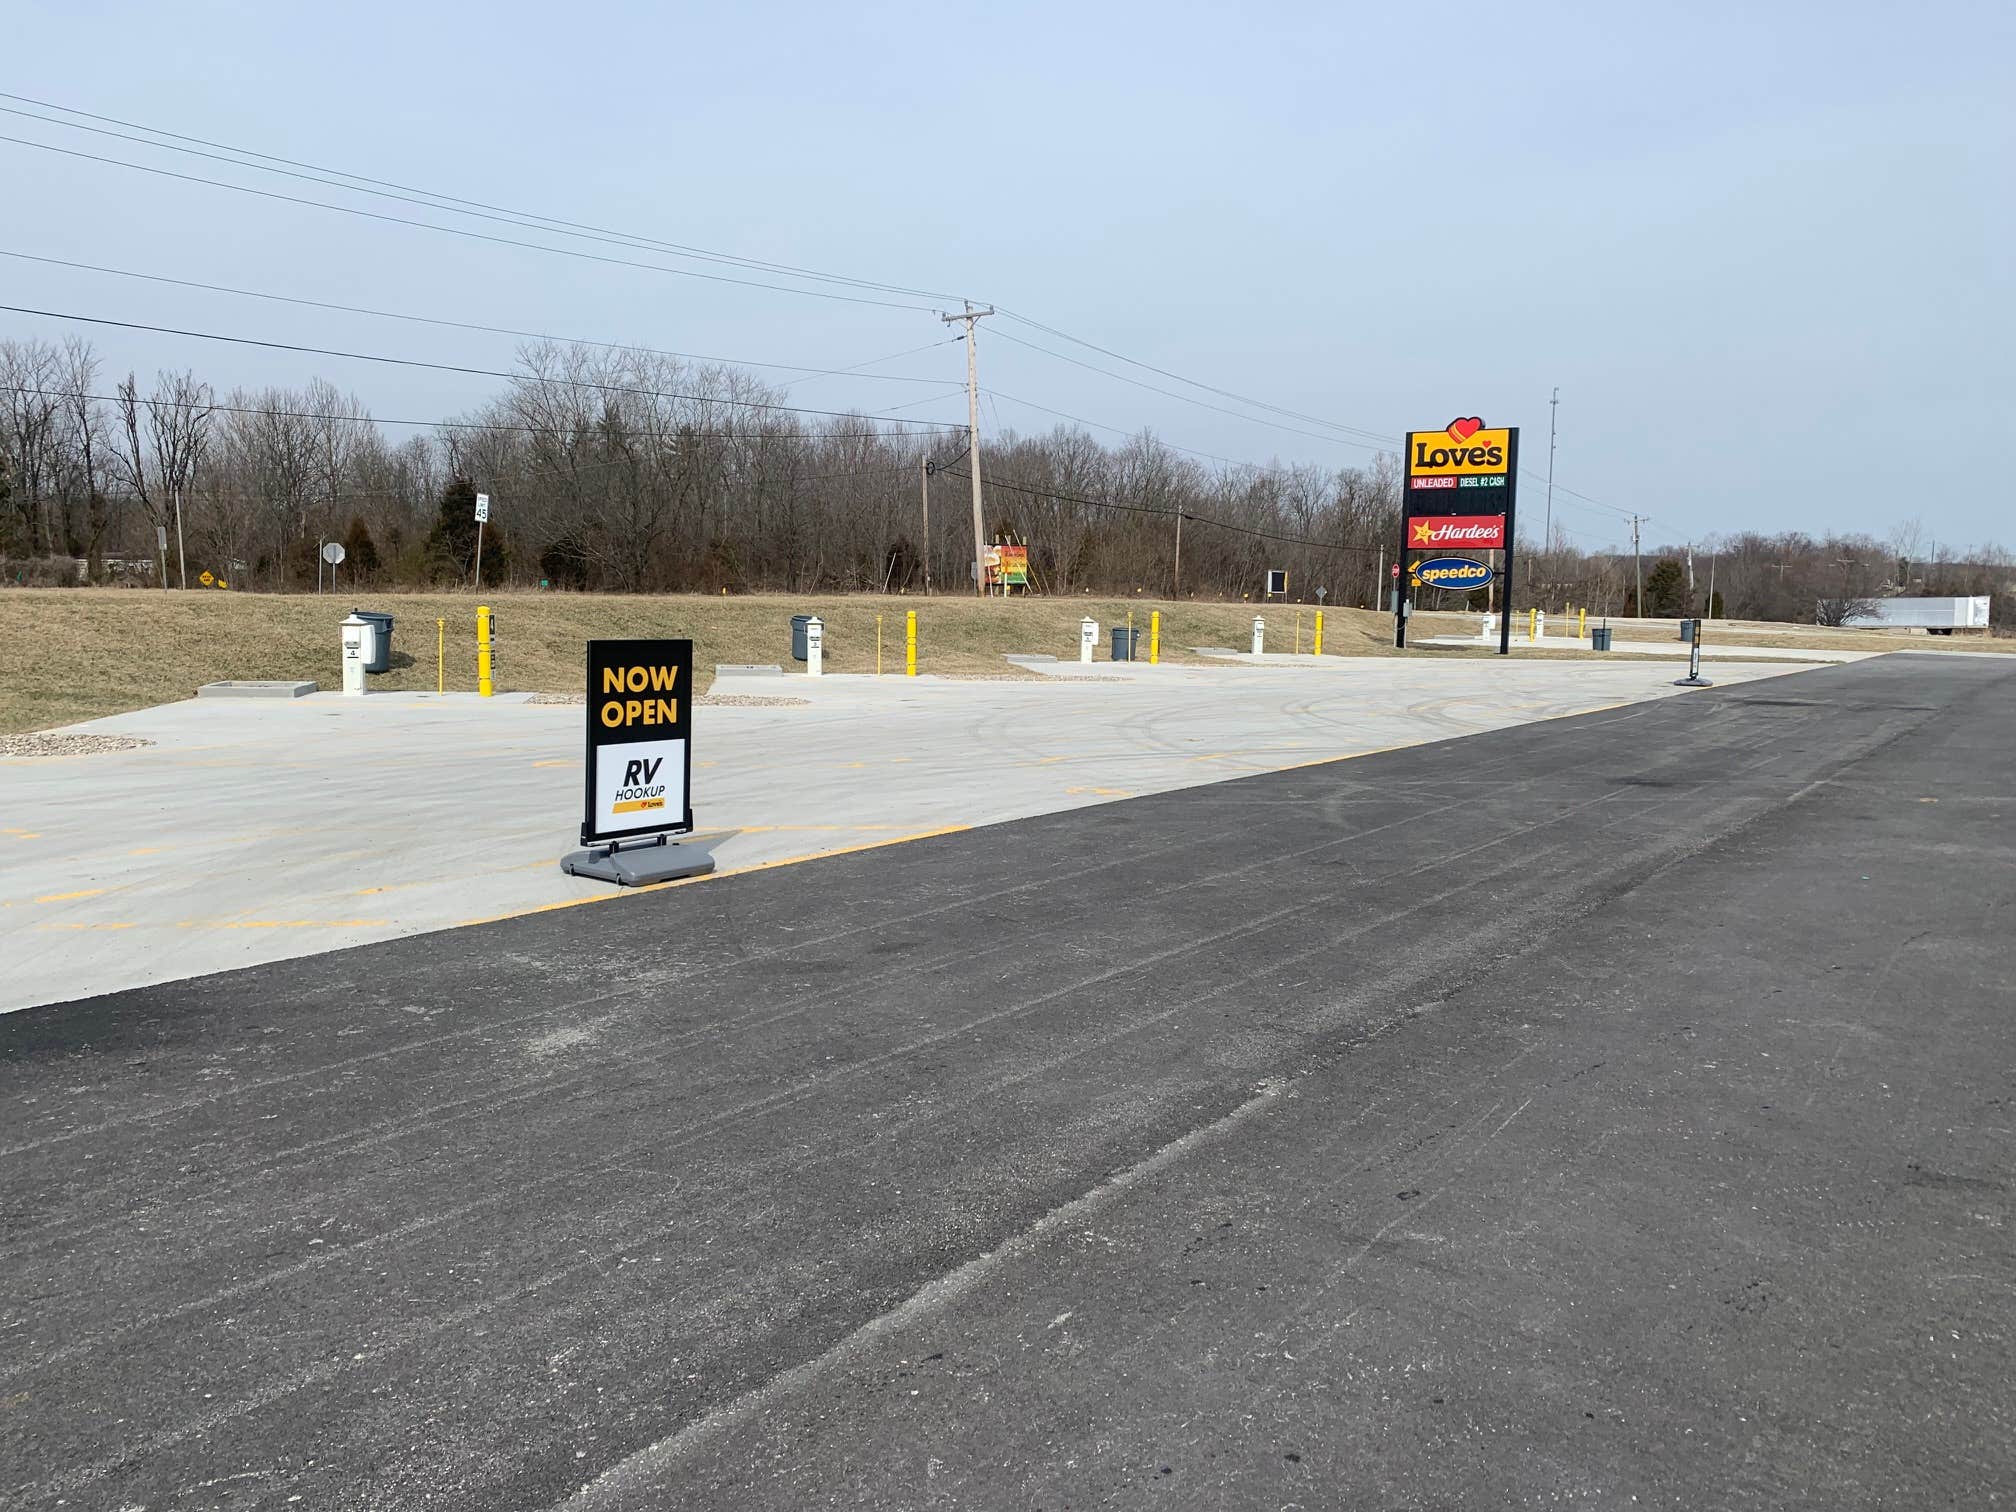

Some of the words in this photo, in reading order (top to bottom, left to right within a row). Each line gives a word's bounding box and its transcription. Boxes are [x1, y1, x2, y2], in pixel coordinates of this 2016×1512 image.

[1413, 477, 1454, 489] UNLEADED
[1460, 477, 1479, 487] DIESEL
[1480, 477, 1489, 487] #2
[1489, 476, 1505, 486] CASH
[476, 508, 487, 519] 45
[1431, 524, 1500, 541] Hardee's
[1422, 564, 1487, 582] speedco
[603, 666, 678, 693] NOW
[601, 699, 677, 728] OPEN
[623, 757, 664, 787] RV
[615, 785, 666, 801] HOOKUP
